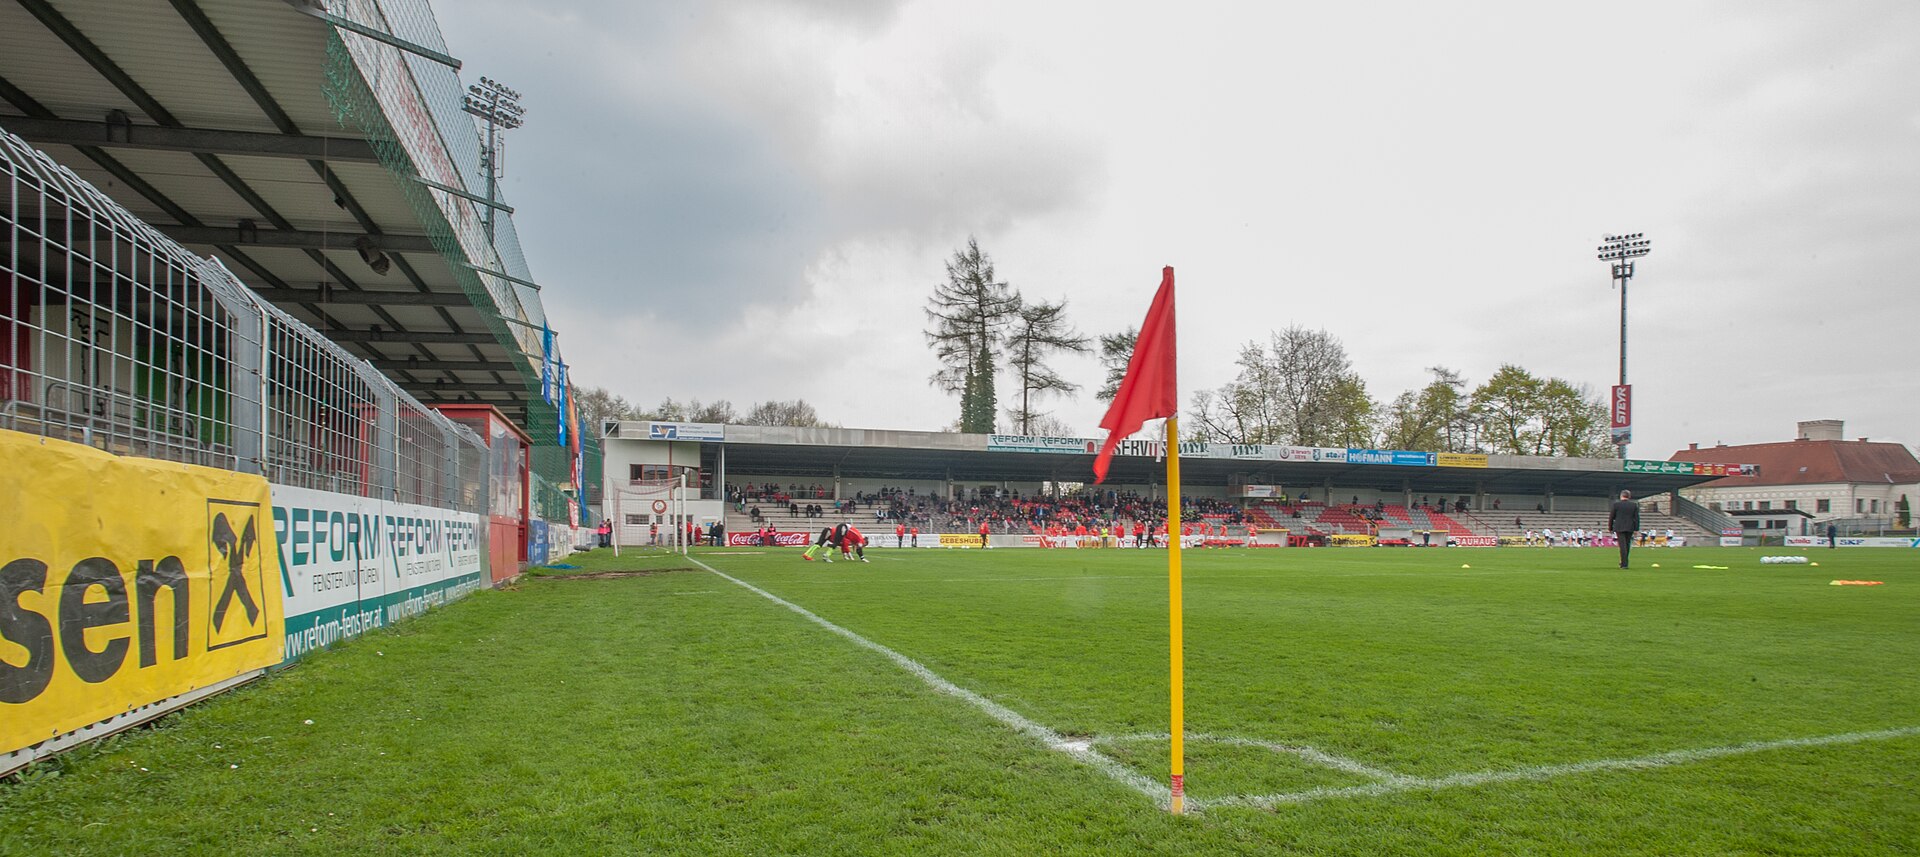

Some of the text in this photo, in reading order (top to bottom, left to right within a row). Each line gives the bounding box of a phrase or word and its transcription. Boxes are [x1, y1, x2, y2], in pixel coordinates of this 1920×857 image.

[1616, 387, 1626, 424] STEYR
[991, 435, 1035, 445] REFORM
[1040, 437, 1083, 447] REFORM
[1349, 452, 1393, 463] HOFMANN
[272, 506, 380, 597] REFORM
[385, 515, 442, 578] REFORM
[444, 520, 478, 568] REFORM
[1455, 537, 1496, 546] BAUHAUS
[313, 567, 380, 593] FENSTER UND TÜREN
[0, 556, 189, 704] sen
[284, 604, 383, 659] w.reform-fenster.at
